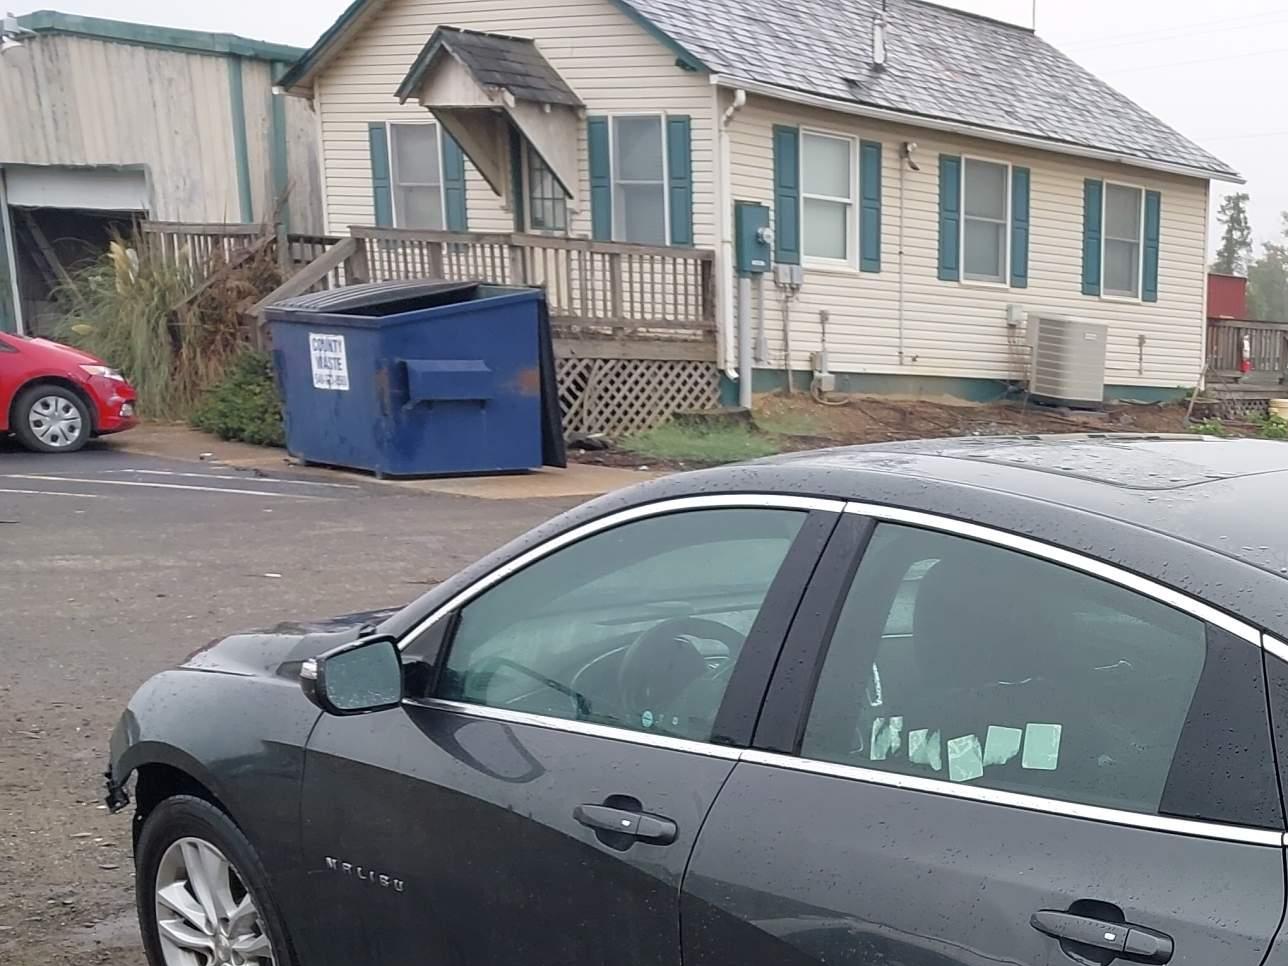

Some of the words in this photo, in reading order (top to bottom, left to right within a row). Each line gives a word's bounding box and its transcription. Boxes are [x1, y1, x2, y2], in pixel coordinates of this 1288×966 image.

[312, 337, 342, 352] COUNTY
[316, 356, 342, 371] WASTE
[325, 856, 404, 892] MALIBU
